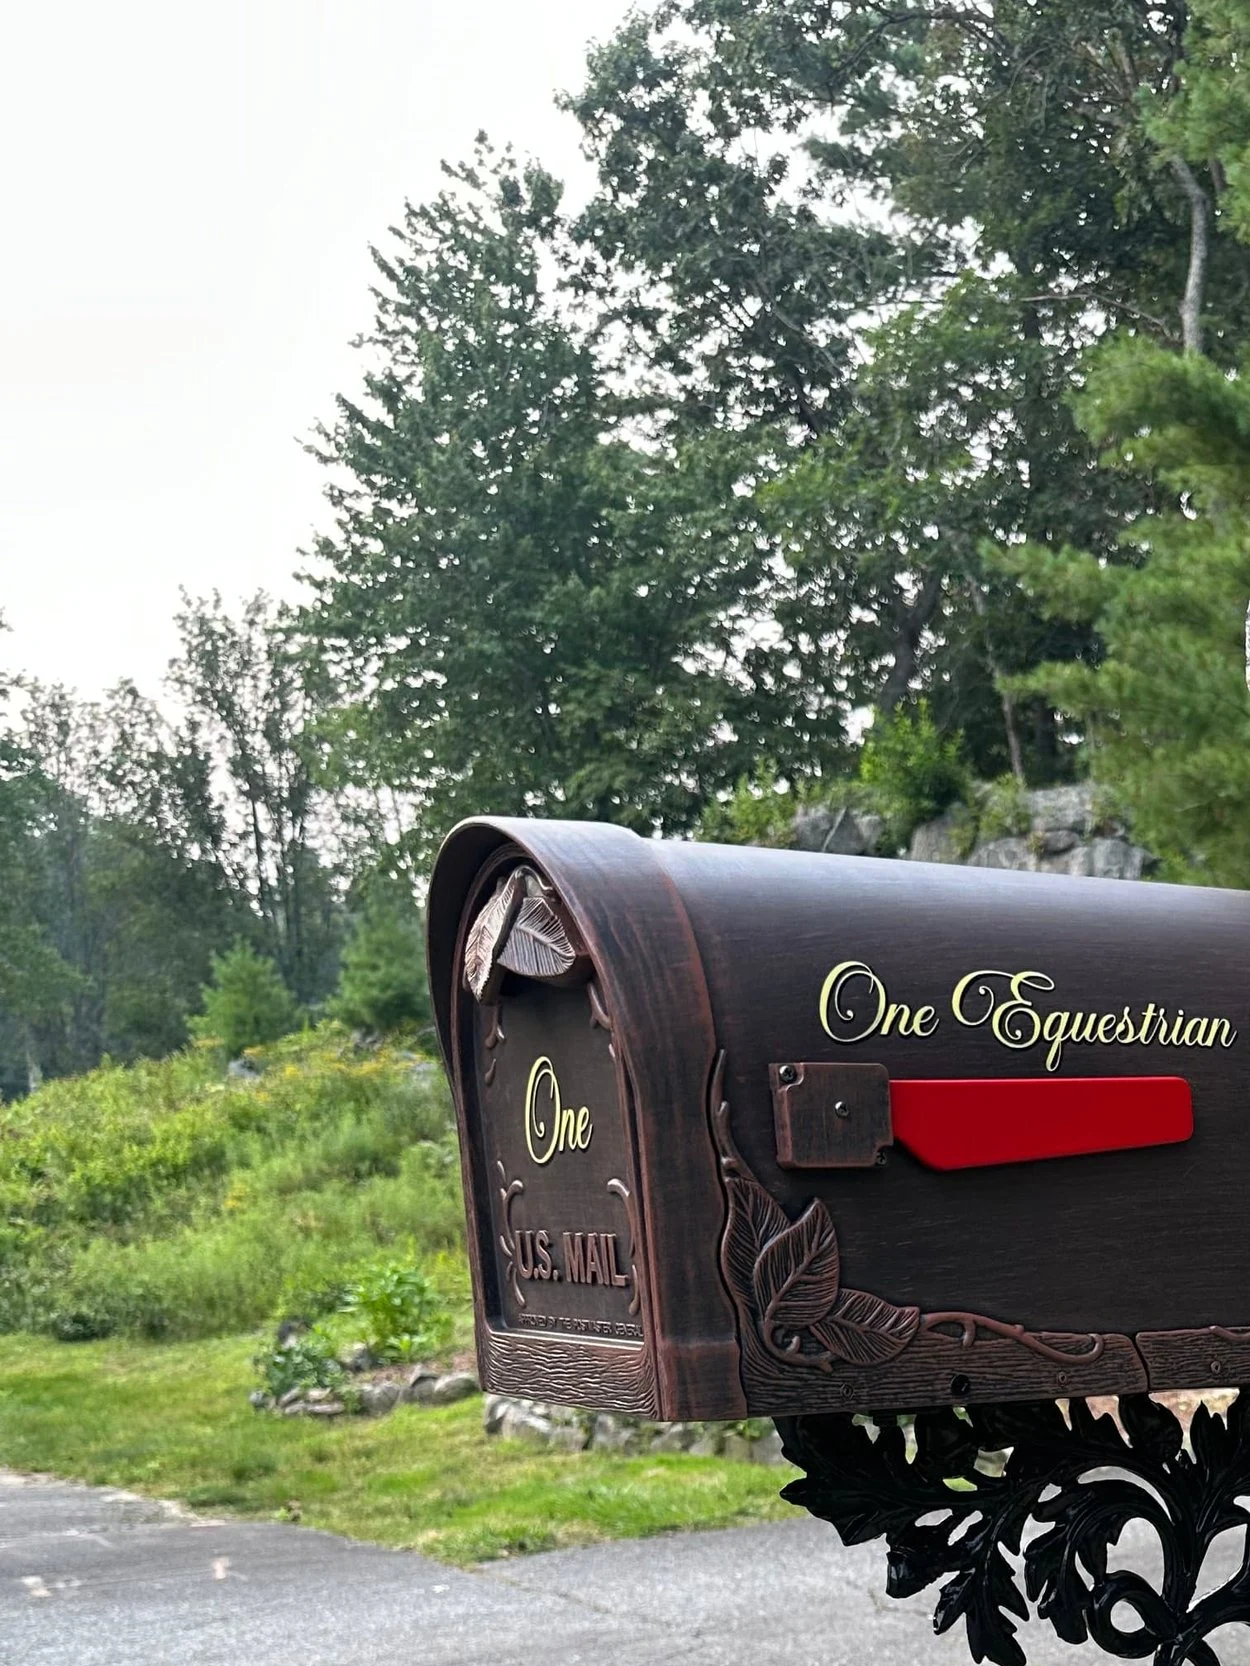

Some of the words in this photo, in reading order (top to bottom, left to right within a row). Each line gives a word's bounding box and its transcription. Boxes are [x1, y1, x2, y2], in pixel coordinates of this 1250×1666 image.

[818, 960, 939, 1043] One
[951, 969, 1238, 1073] Equestrian
[525, 1055, 593, 1164] One
[515, 1230, 559, 1281] U.S.
[562, 1232, 629, 1287] MAIL
